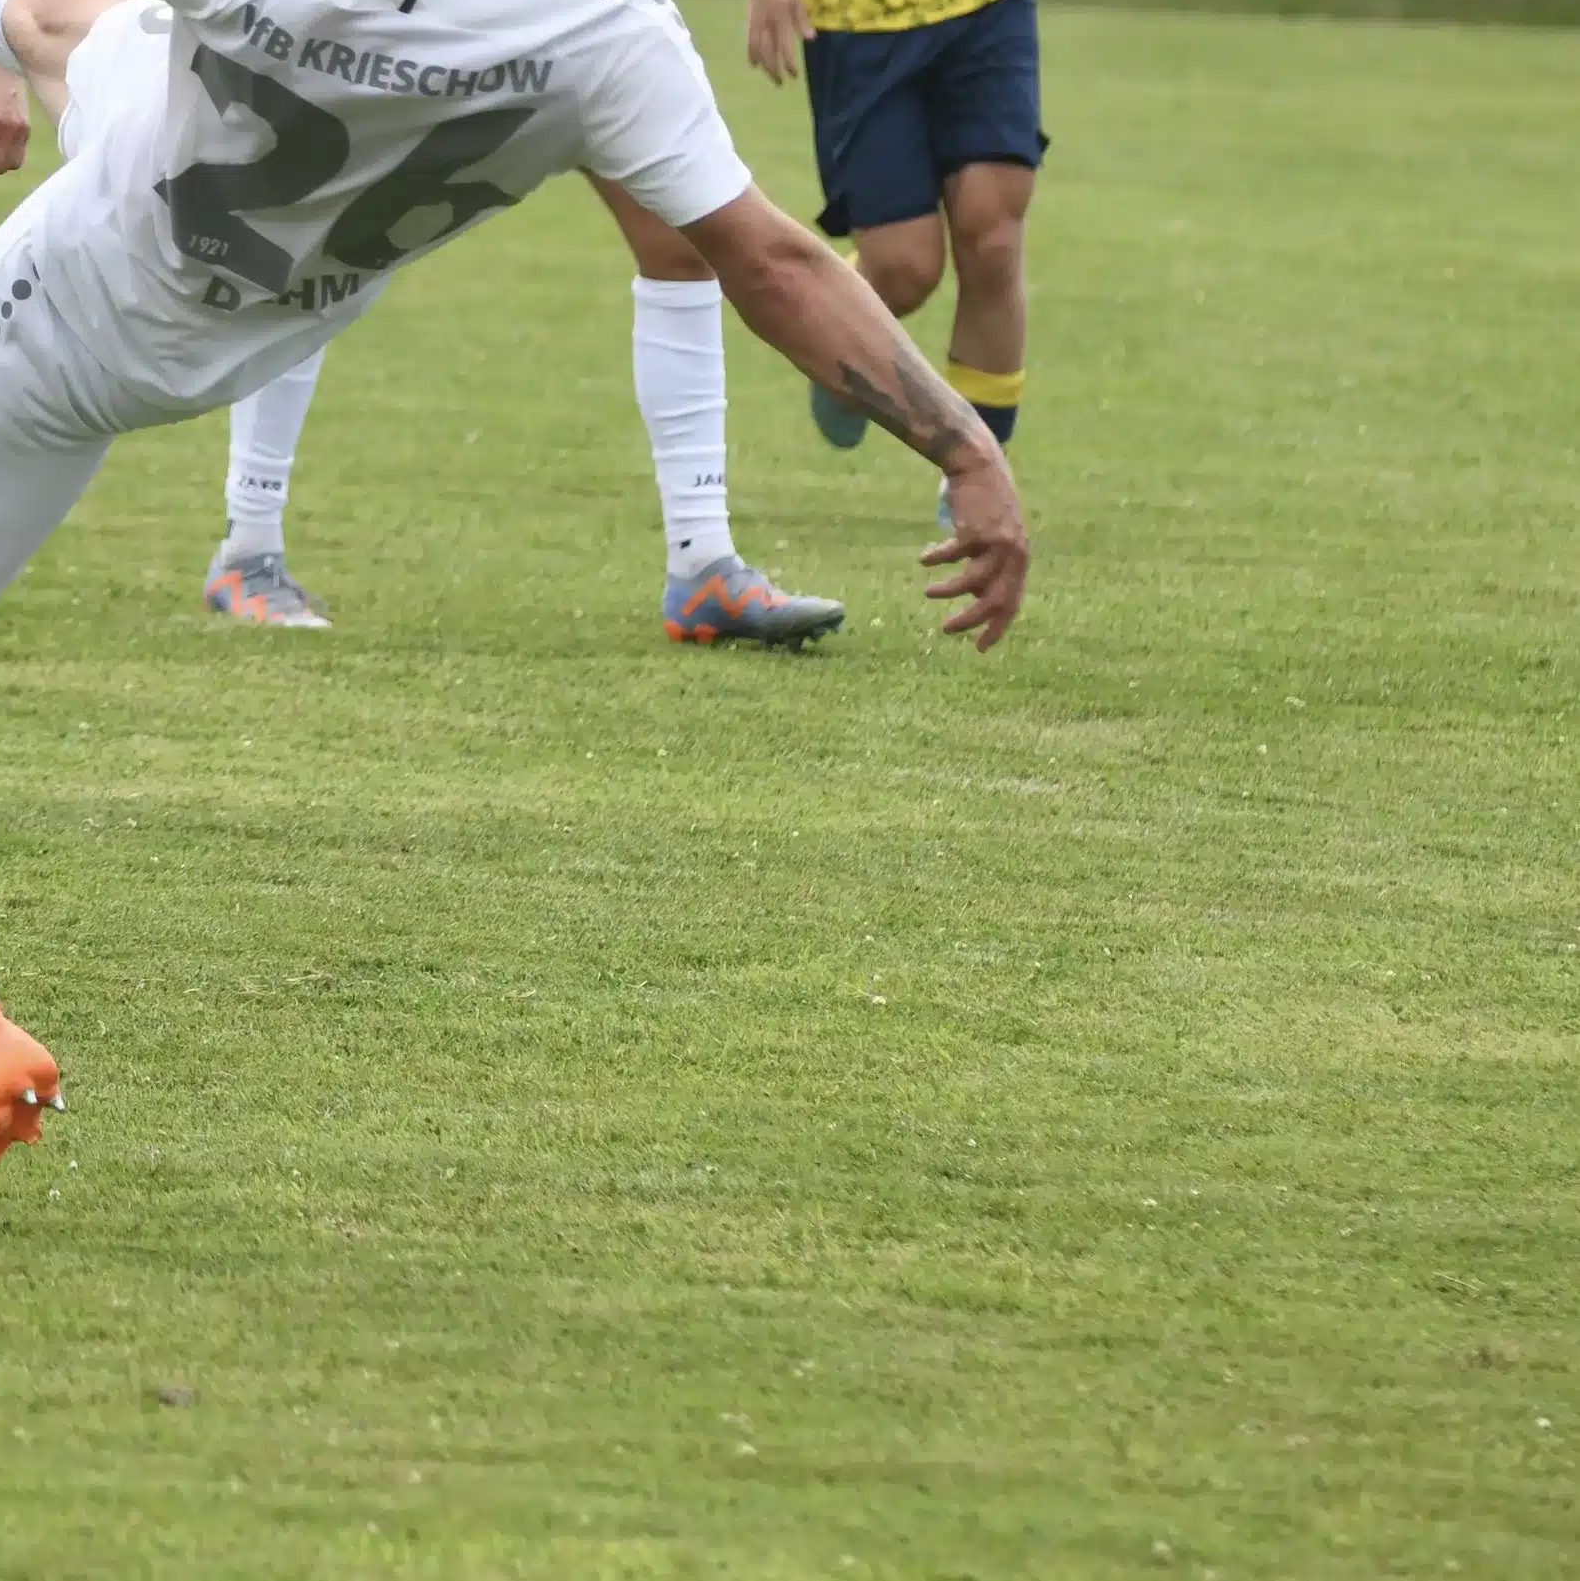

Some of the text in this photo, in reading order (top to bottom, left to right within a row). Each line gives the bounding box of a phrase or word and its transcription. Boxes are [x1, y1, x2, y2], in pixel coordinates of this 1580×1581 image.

[297, 37, 554, 97] KRIESCHOW
[153, 43, 538, 270] 26
[189, 233, 230, 257] 1921
